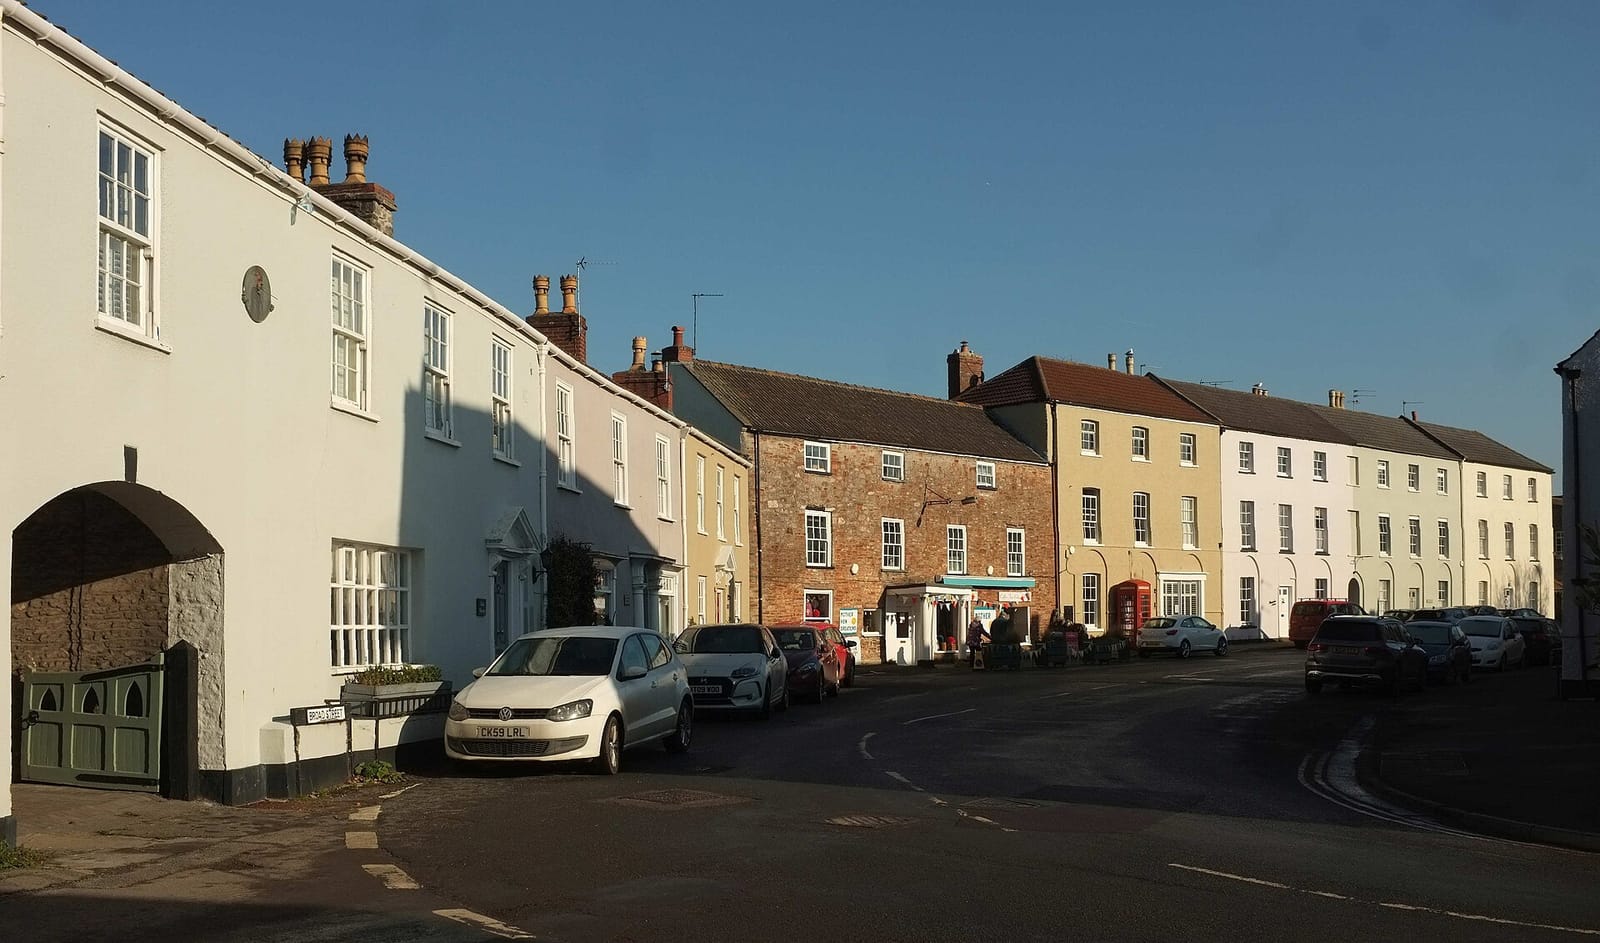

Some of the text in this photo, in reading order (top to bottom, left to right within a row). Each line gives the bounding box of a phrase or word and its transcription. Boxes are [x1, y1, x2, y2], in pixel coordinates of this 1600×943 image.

[309, 708, 343, 721] BROAD STREET
[481, 727, 525, 738] CK59 LRL
